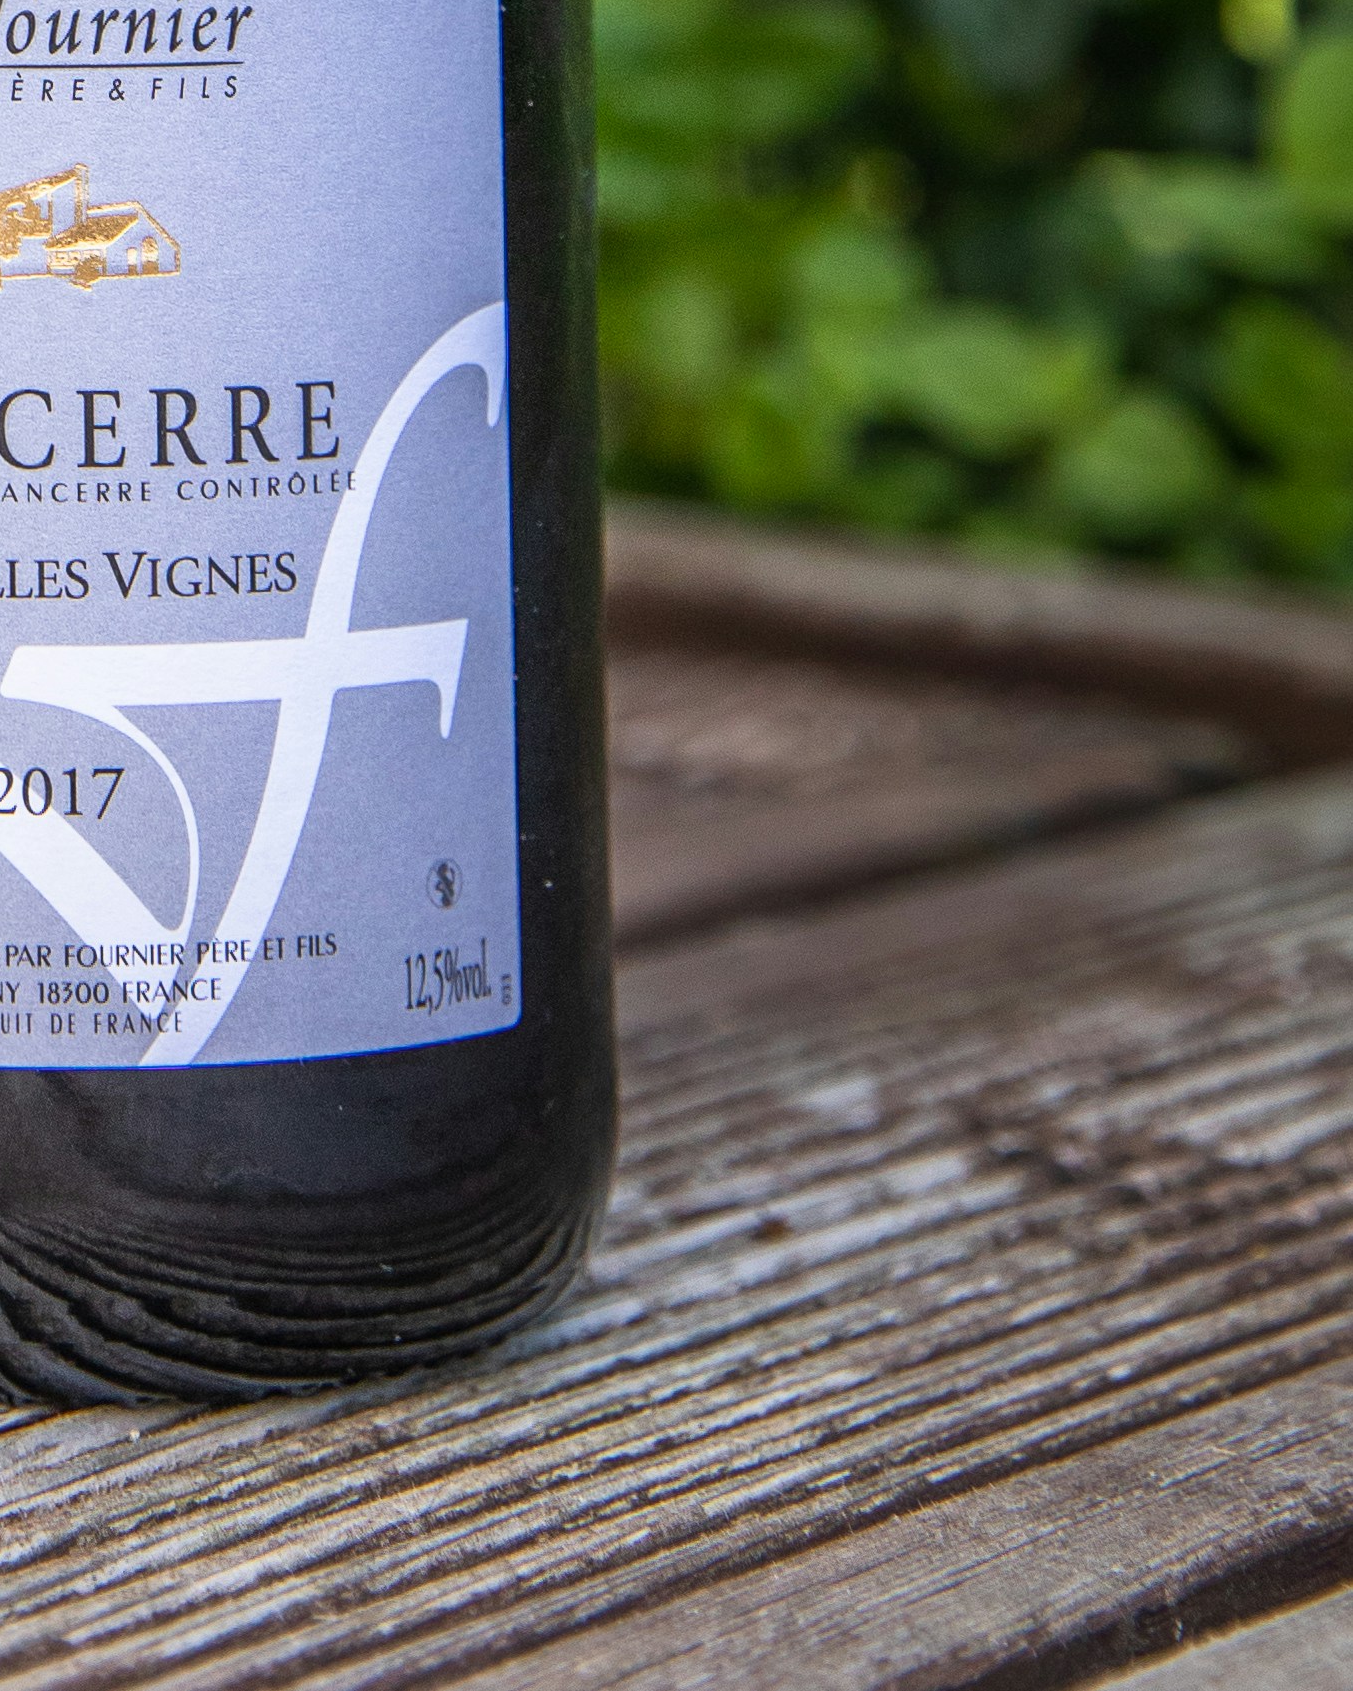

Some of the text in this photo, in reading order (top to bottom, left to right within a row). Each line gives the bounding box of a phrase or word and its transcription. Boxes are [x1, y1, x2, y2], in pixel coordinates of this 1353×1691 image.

[108, 77, 126, 101] &
[150, 74, 239, 100] FILS
[176, 469, 357, 501] CONTRÔLÉE
[101, 551, 297, 598] VIGNES
[5, 943, 52, 968] PAR
[63, 943, 185, 968] FOURNIER
[196, 937, 252, 965] PÈRE
[263, 937, 285, 961] ET
[297, 932, 338, 959] FILS
[38, 981, 110, 1005] 18300
[122, 977, 222, 1004] FRANCE
[50, 1013, 76, 1035] DE
[93, 1010, 183, 1034] FRANCE
